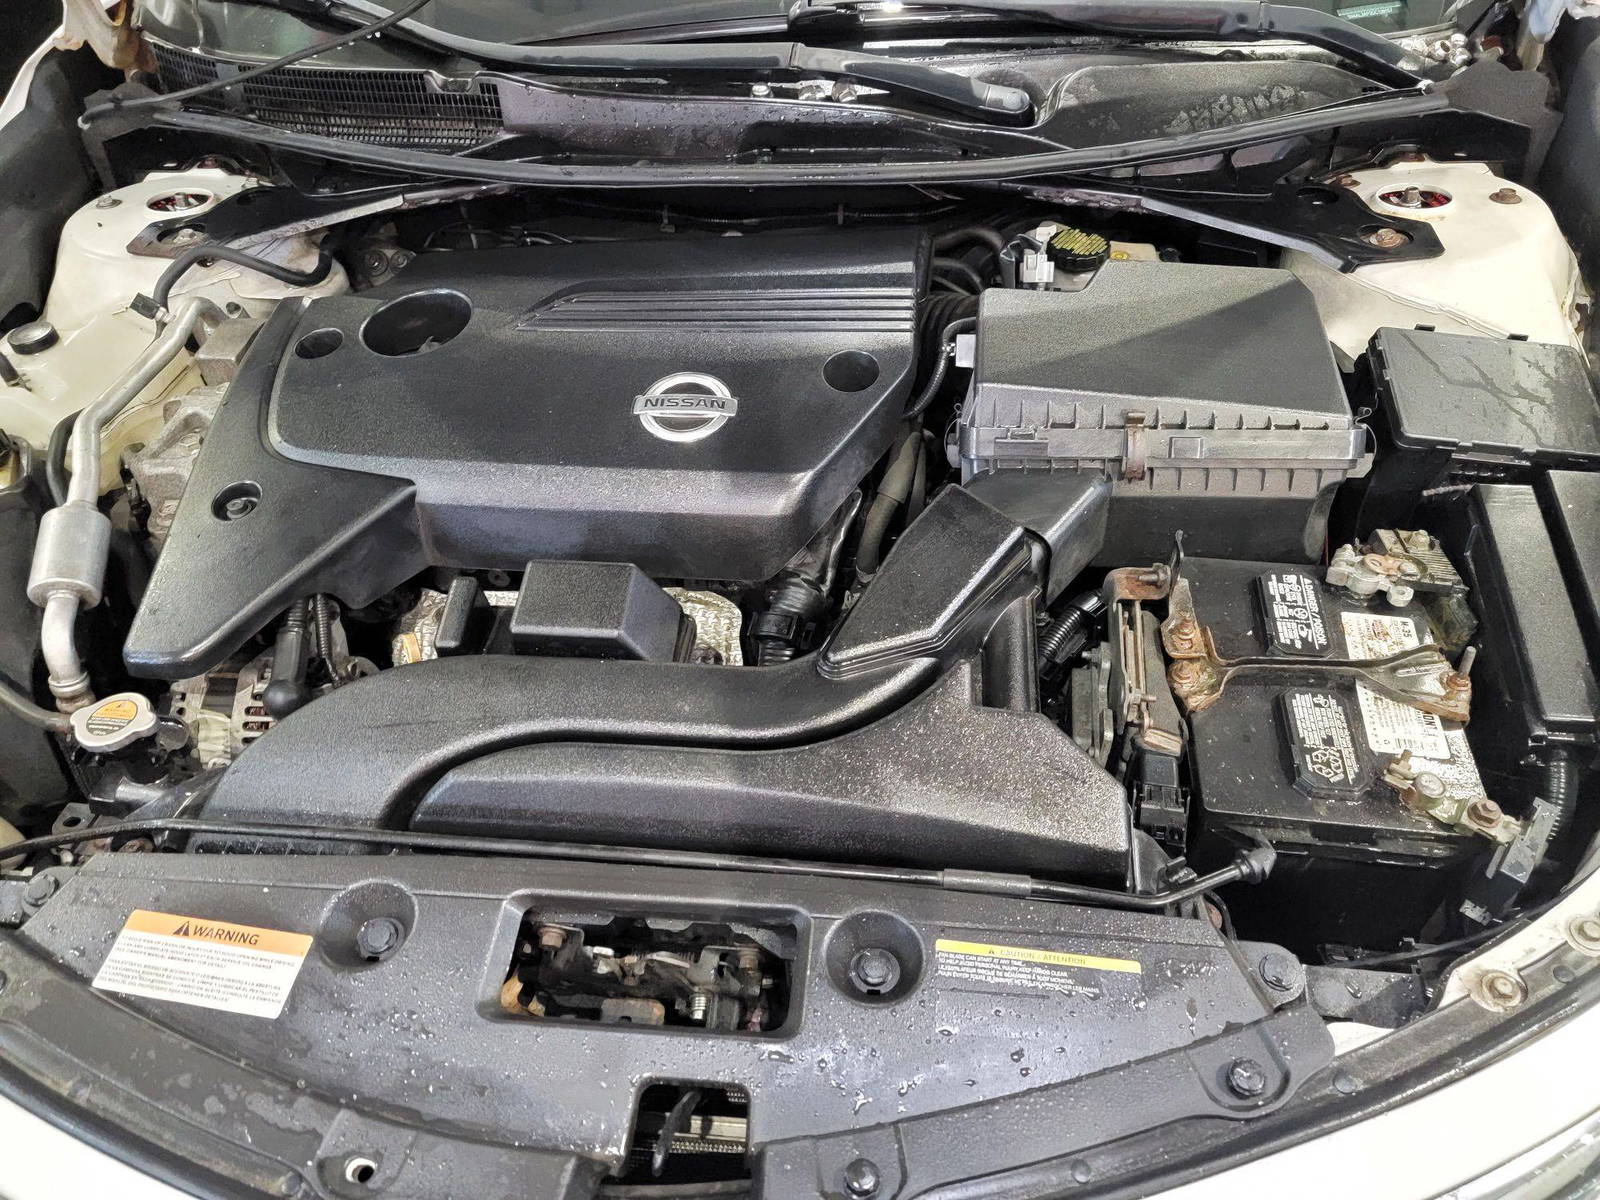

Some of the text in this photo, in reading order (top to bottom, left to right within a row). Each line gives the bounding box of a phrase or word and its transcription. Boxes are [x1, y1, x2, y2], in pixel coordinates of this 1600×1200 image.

[644, 398, 726, 409] NISSAN
[193, 925, 260, 945] WARNING
[1000, 949, 1035, 960] CAUTION
[1043, 954, 1086, 965] ATTENTION
